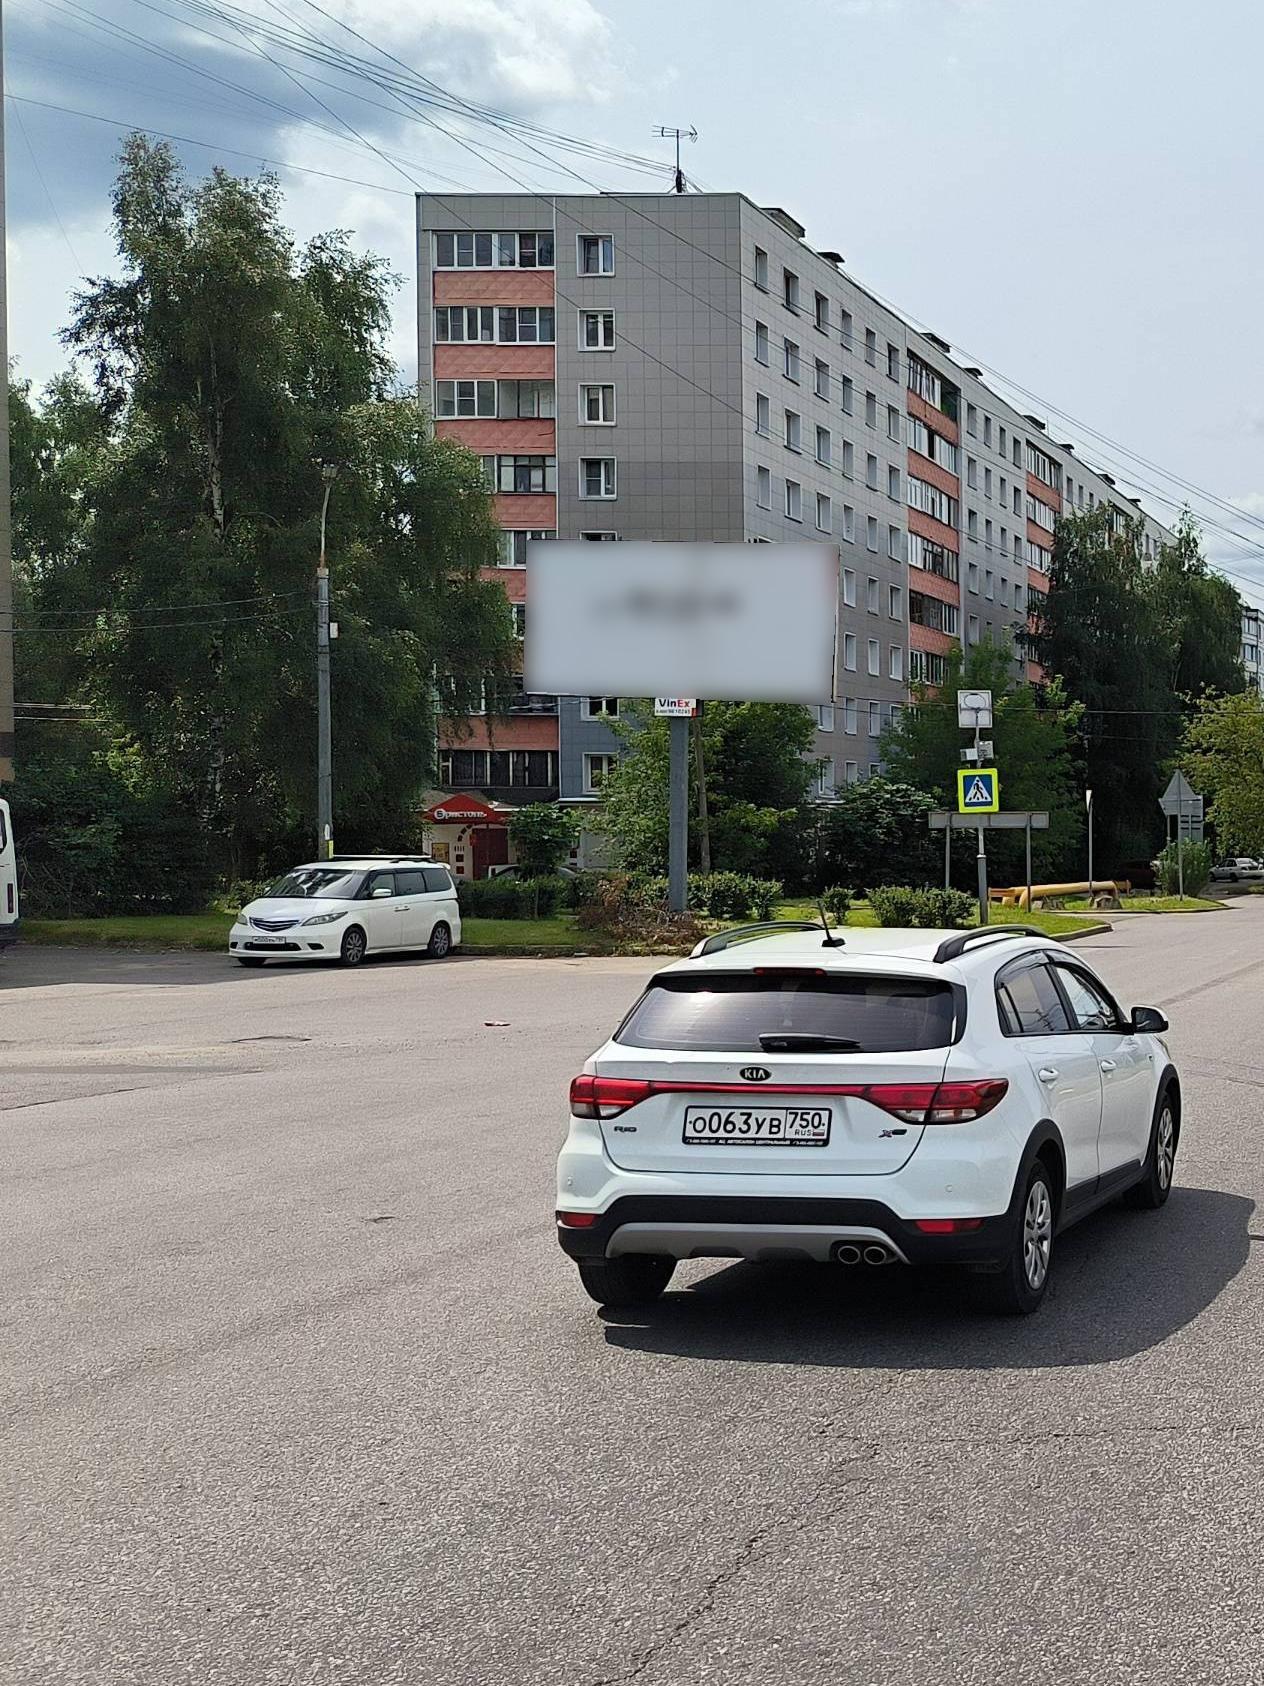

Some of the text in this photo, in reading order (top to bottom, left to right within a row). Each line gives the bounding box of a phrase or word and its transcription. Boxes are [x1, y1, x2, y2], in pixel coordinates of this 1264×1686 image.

[744, 1069, 767, 1079] KIA
[691, 1111, 823, 1135] О063УВ 750
[794, 1129, 813, 1137] RUS
